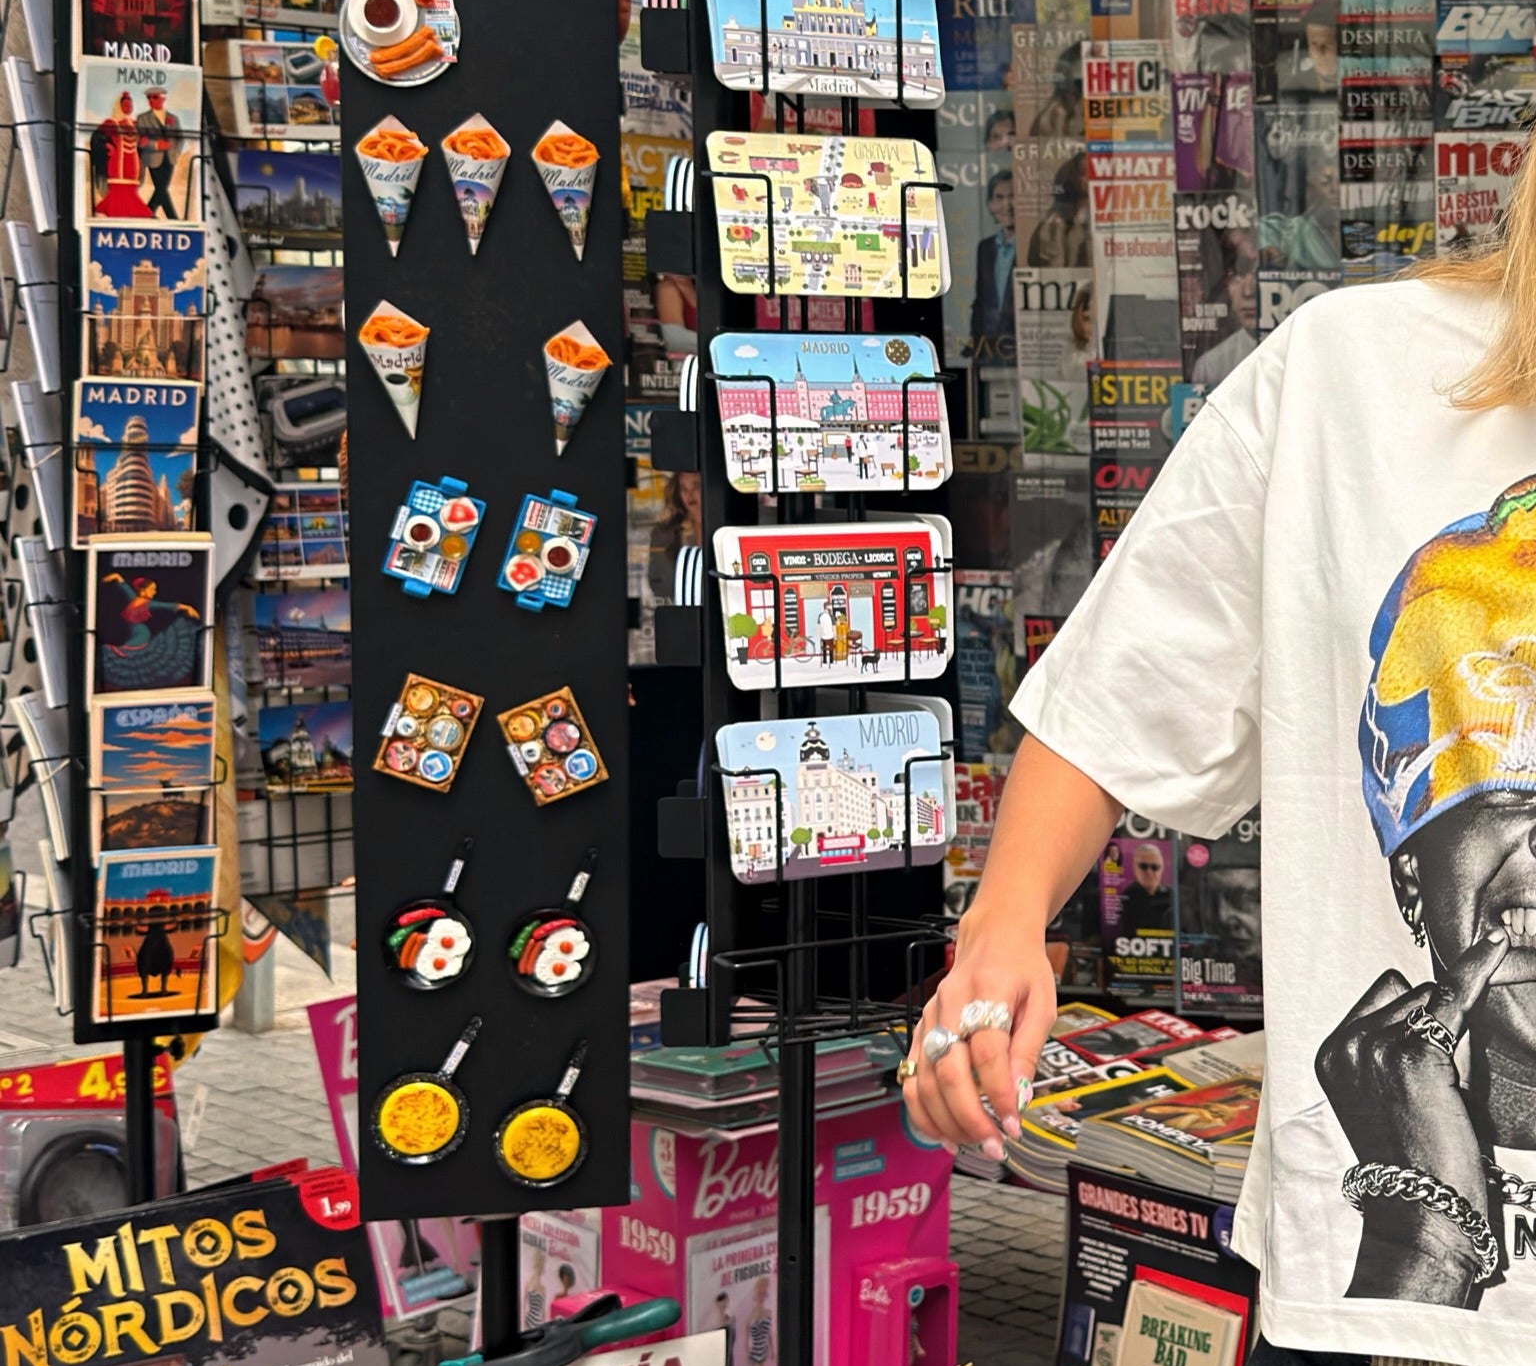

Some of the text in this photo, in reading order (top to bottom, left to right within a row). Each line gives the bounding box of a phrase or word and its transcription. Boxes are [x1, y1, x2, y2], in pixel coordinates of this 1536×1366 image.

[1342, 29, 1426, 45] DESPERTA
[104, 41, 171, 64] MADRID
[118, 67, 166, 84] MADRID
[807, 78, 859, 94] Madrid
[1347, 91, 1430, 109] DESPERTA
[449, 160, 502, 179] Madrid
[1343, 152, 1427, 170] DESPERTA
[362, 161, 416, 182] Madrid
[542, 168, 593, 188] Madrid
[1455, 191, 1499, 212] BESTIA
[97, 232, 191, 251] MADRID
[802, 341, 850, 354] MADRID
[370, 347, 423, 369] Madrid
[548, 362, 601, 387] Madrid
[88, 386, 187, 406] MADRID
[112, 551, 193, 567] MADRID
[814, 552, 858, 565] BODEGA
[859, 712, 920, 747] MADRID
[121, 859, 198, 877] MADRID
[1115, 938, 1173, 956] SOFT
[852, 1182, 930, 1227] 1959
[1077, 1180, 1138, 1215] GRANDES
[620, 1215, 677, 1263] 1959
[61, 1208, 276, 1297] MITOS
[1140, 1313, 1212, 1355] BREAKING
